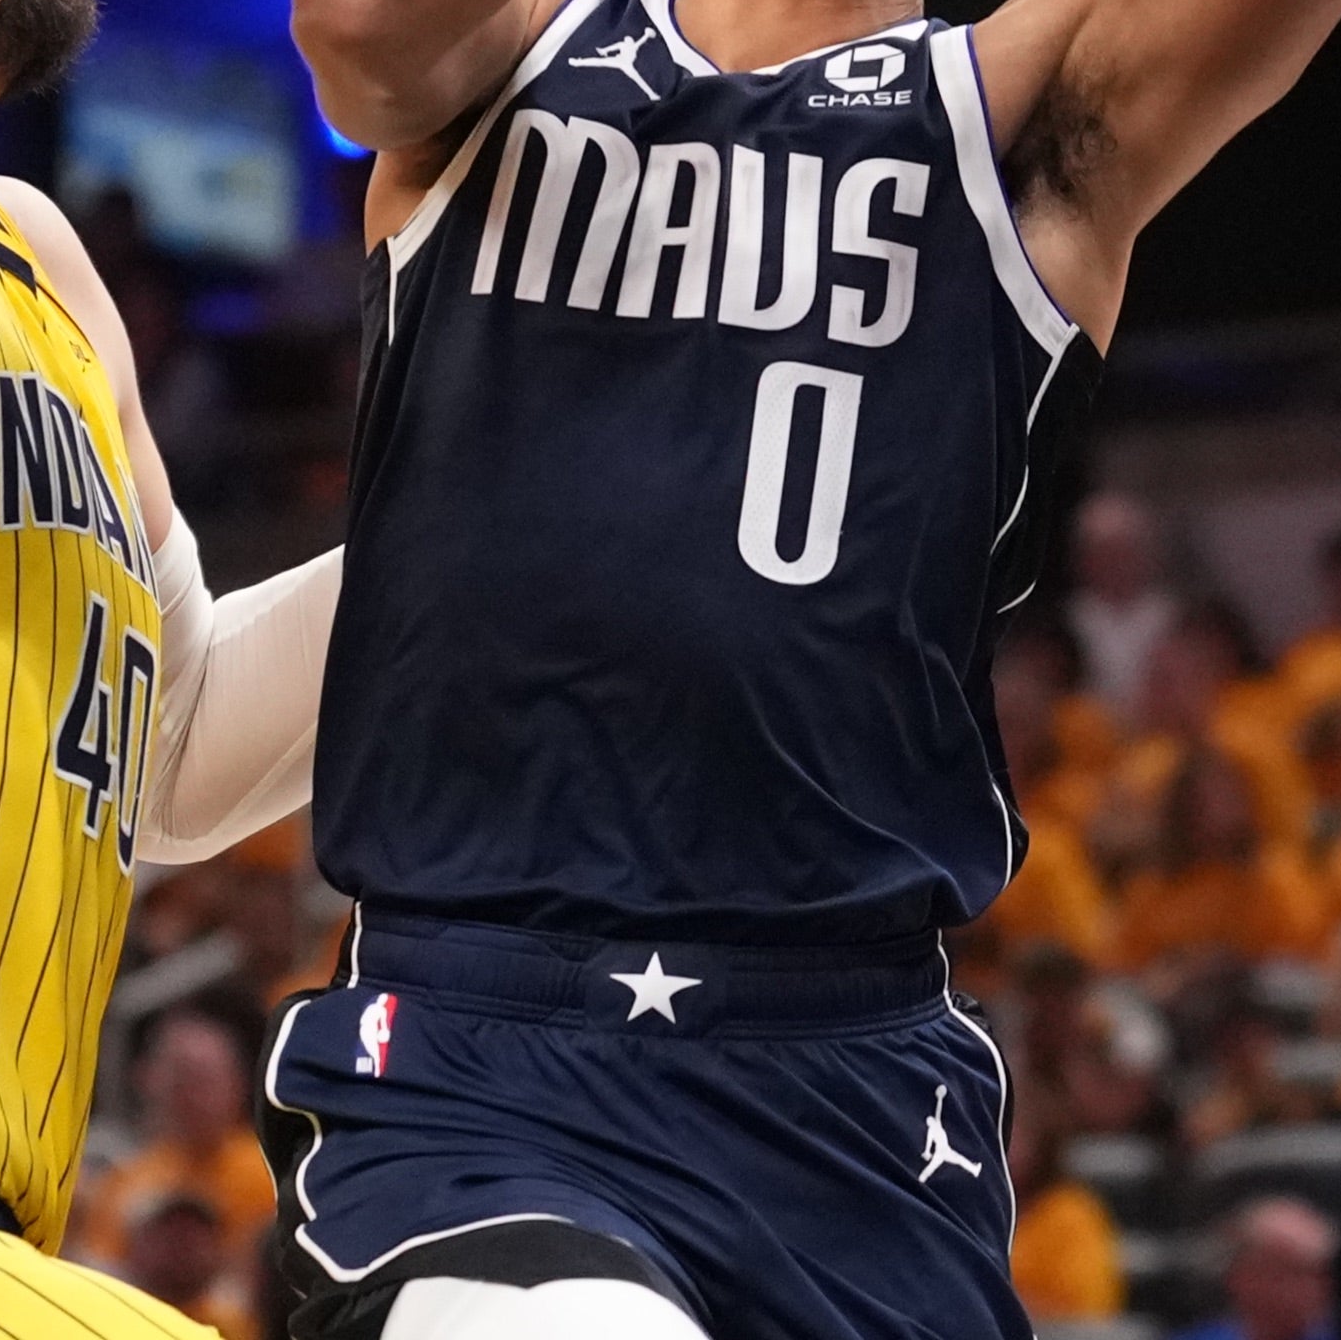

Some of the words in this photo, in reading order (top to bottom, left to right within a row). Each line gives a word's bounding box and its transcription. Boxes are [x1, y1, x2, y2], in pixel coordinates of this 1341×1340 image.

[807, 89, 913, 108] CHASE
[470, 108, 931, 349] MAVS
[737, 360, 865, 586] 0
[53, 589, 158, 878] 40
